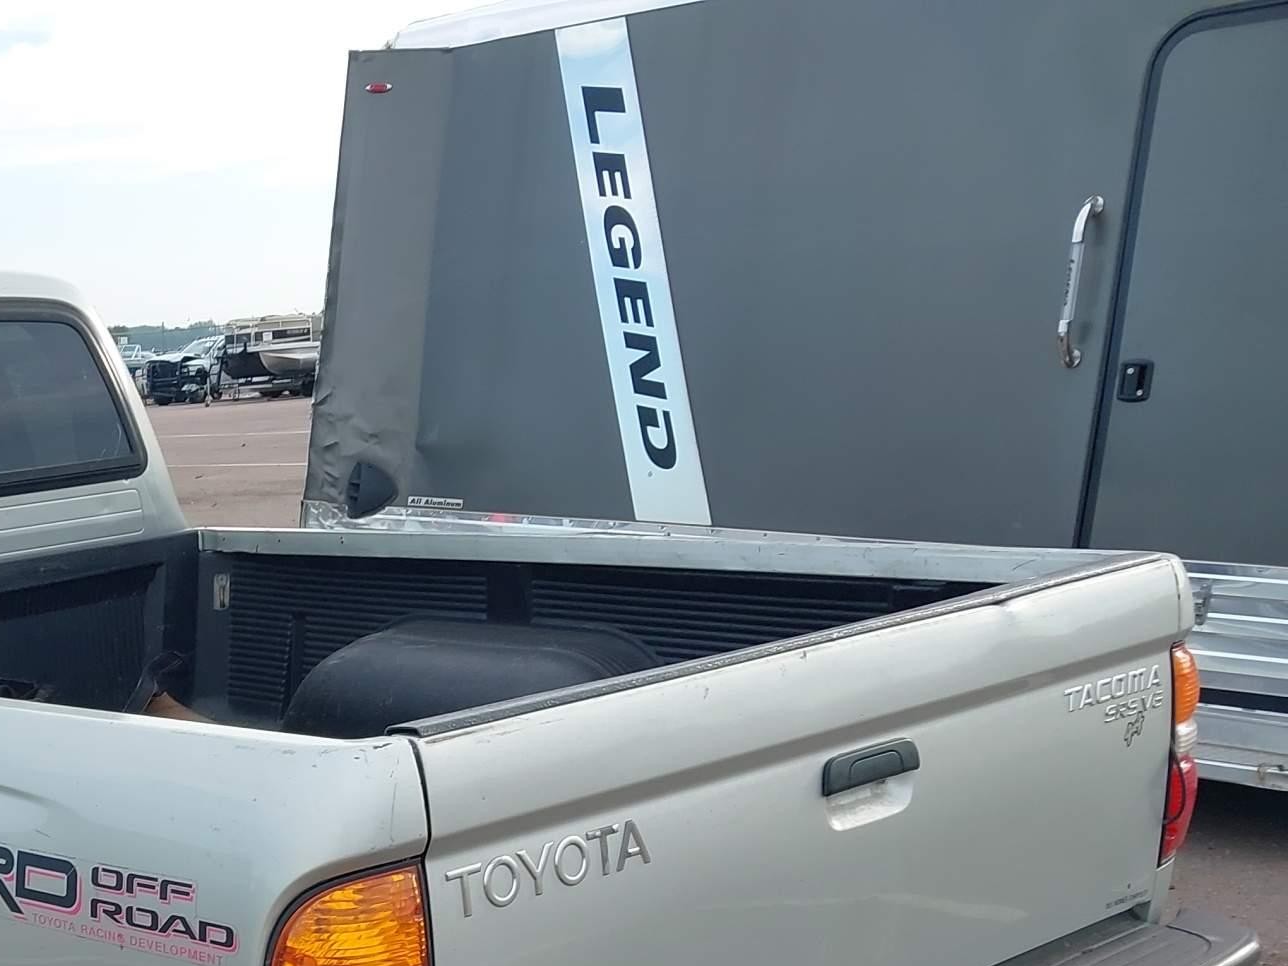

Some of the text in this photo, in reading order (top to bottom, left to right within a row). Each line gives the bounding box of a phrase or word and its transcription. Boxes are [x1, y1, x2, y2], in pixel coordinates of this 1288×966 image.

[581, 86, 677, 470] LEGEND
[1064, 664, 1160, 713] TACOMA
[91, 865, 196, 904] OFF
[445, 817, 651, 918] TOYOTA
[31, 912, 76, 931] TOYOTA
[129, 935, 224, 966] DEVELOPMENT
[90, 898, 239, 953] ROAD
